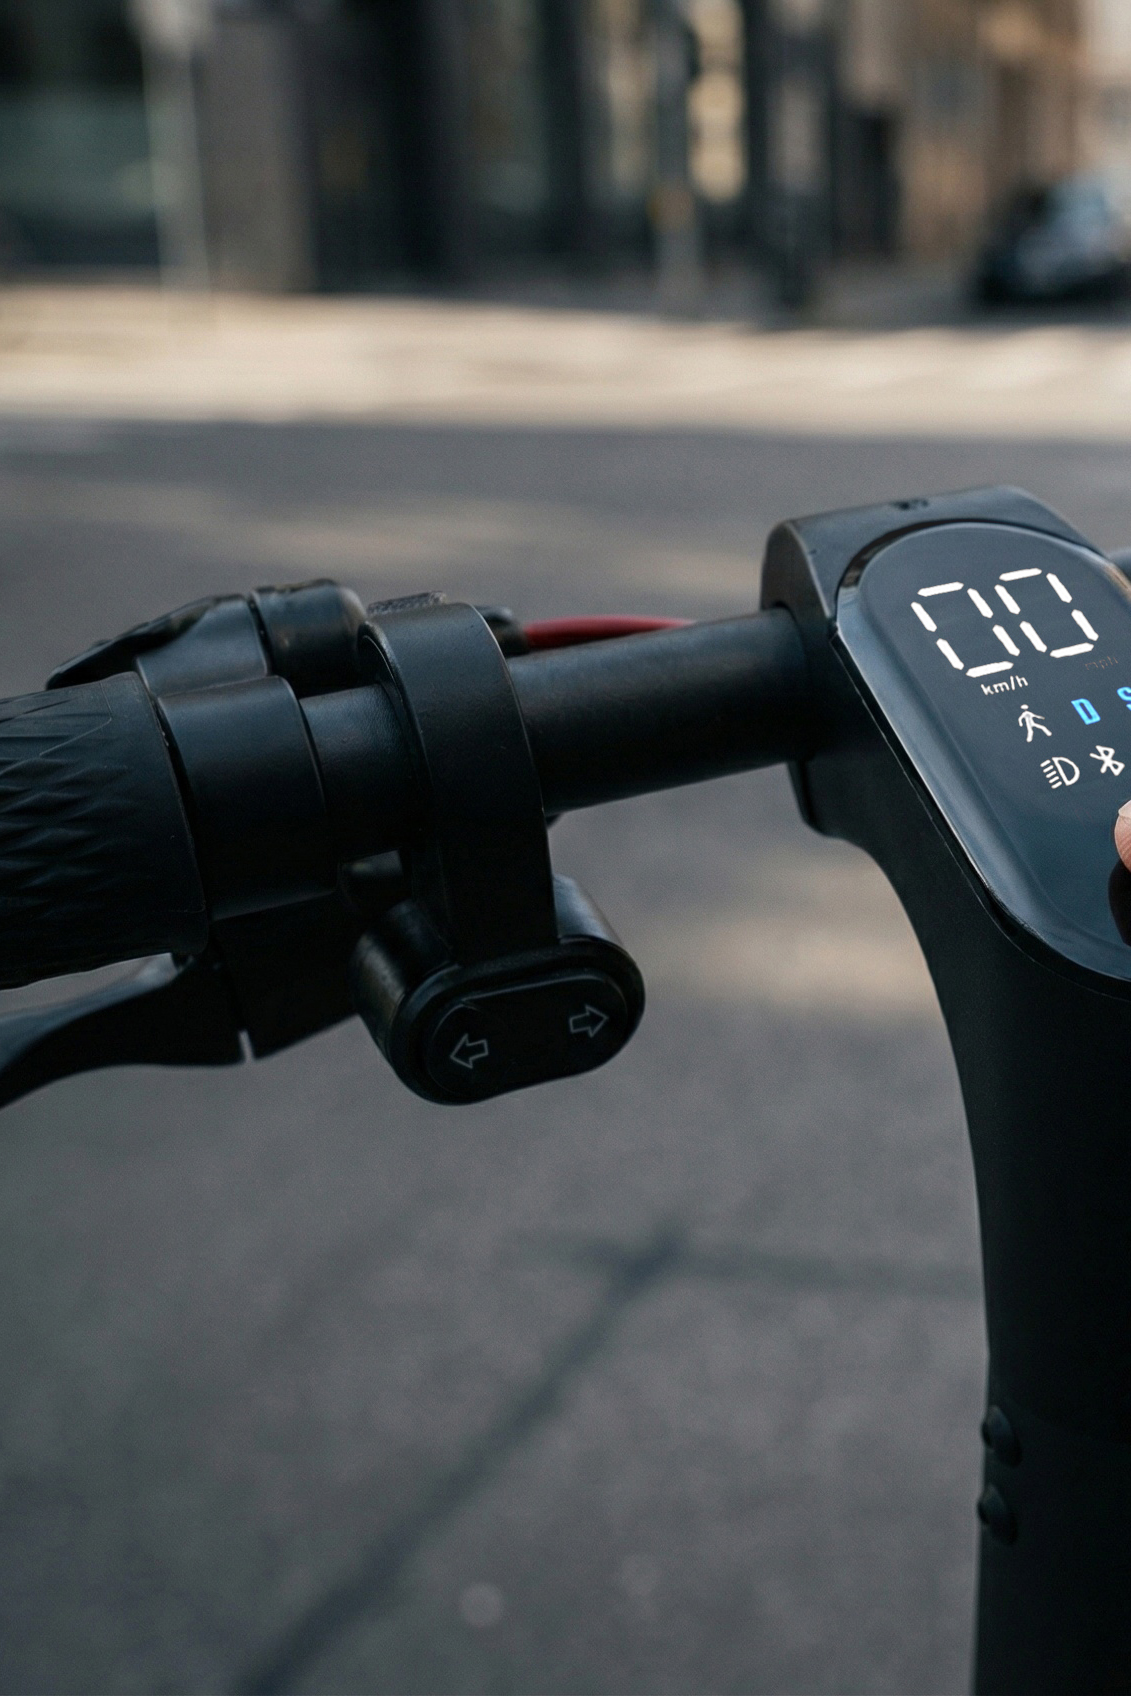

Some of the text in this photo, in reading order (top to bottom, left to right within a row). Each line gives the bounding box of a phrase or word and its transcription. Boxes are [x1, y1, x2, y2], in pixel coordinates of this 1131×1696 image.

[911, 568, 1099, 678] 00
[980, 675, 1029, 695] km/h
[1070, 698, 1101, 725] D
